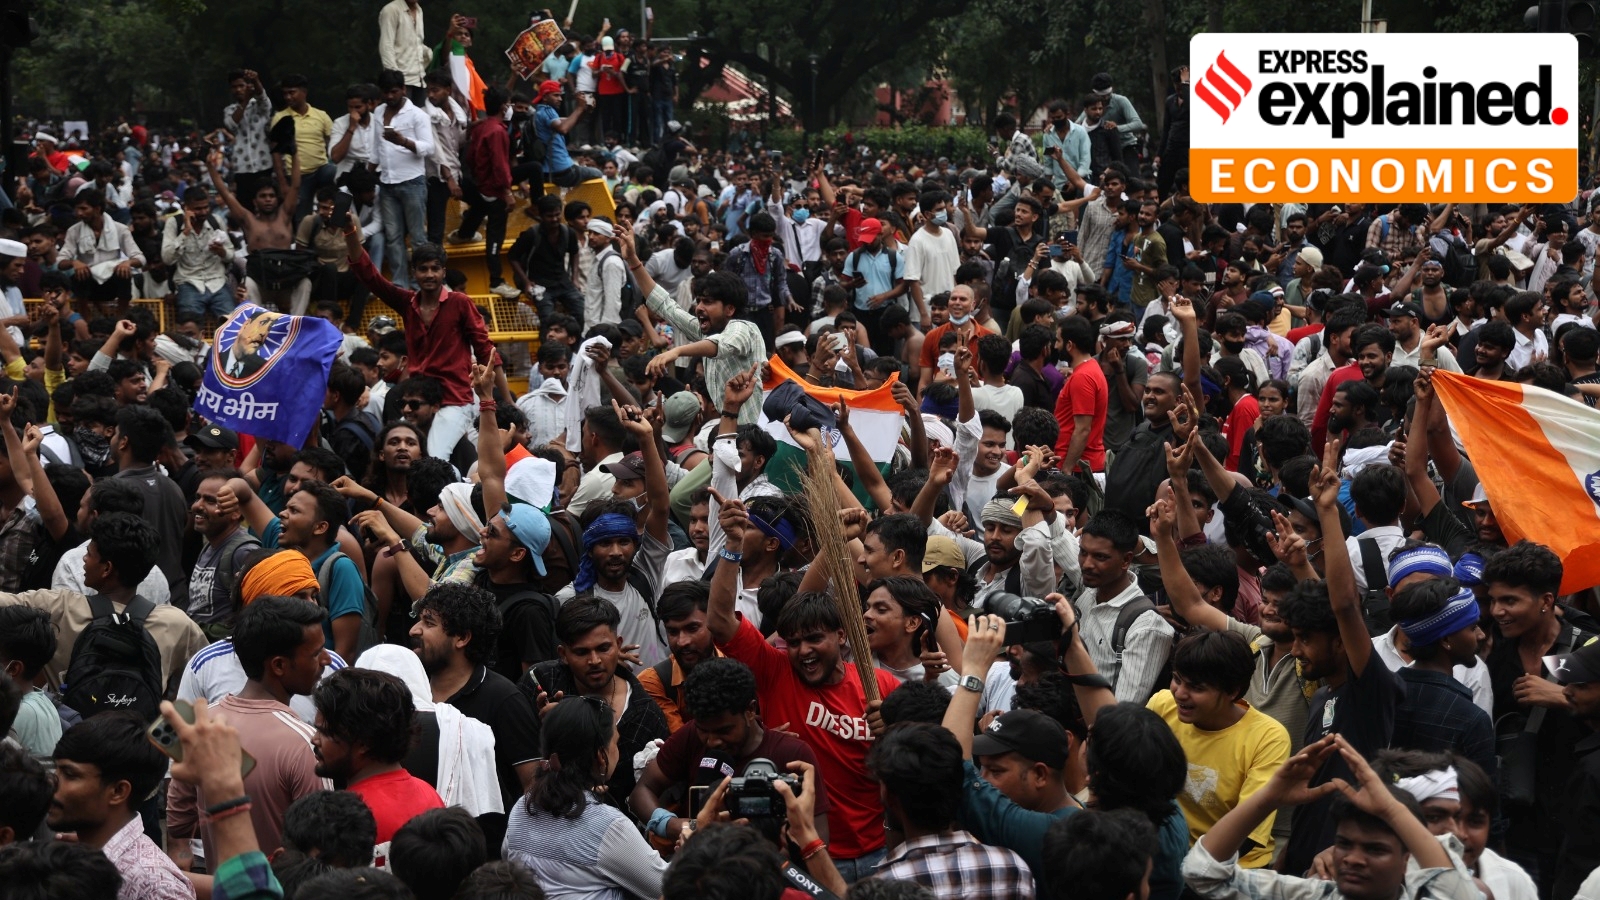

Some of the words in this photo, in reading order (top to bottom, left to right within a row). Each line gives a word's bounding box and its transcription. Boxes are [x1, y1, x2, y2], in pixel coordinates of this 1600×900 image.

[222, 391, 279, 421] भीम
[805, 701, 876, 741] DIESEL
[786, 867, 824, 895] SONY
